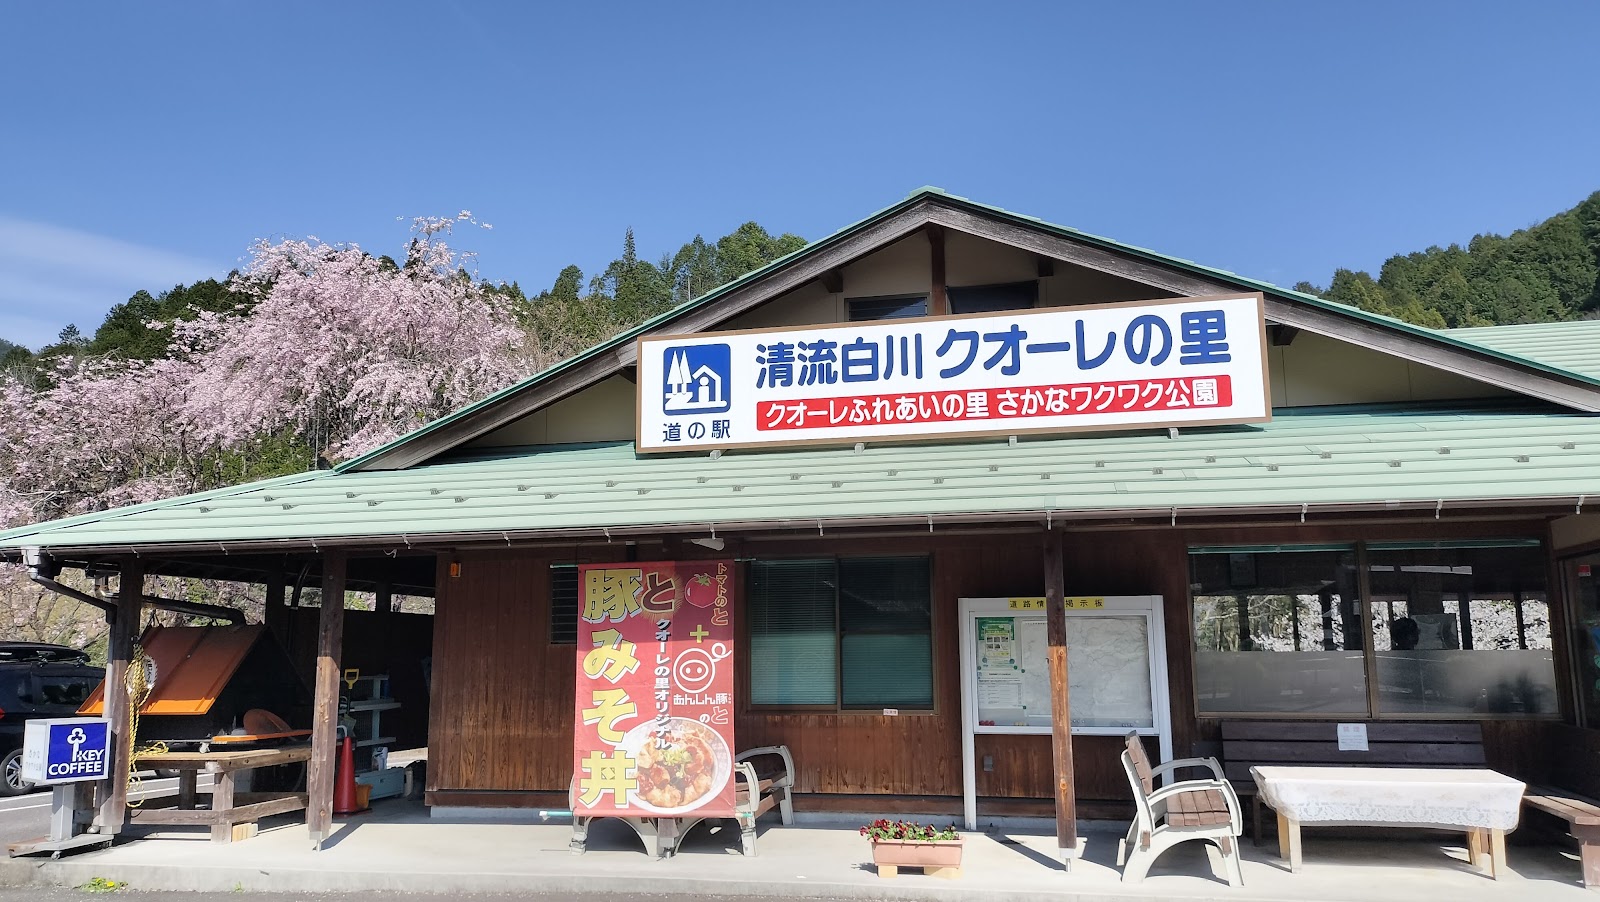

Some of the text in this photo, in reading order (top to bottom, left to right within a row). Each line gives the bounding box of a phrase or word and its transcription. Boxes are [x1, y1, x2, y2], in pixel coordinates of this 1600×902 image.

[756, 309, 1231, 389] 清流白川 クオーレの里
[765, 378, 1219, 428] クオーレふれあいの里 さかなワクワク公園
[662, 419, 731, 442] 道の駅
[711, 563, 728, 625] トマトのと
[1010, 599, 1103, 608] 道路情掲示板
[578, 568, 642, 808] 豚みそ丼
[654, 618, 672, 750] クオーレの里オリジナル
[673, 693, 728, 705] あんしん豚
[48, 761, 102, 775] COFFEE
[78, 749, 105, 761] KEY
